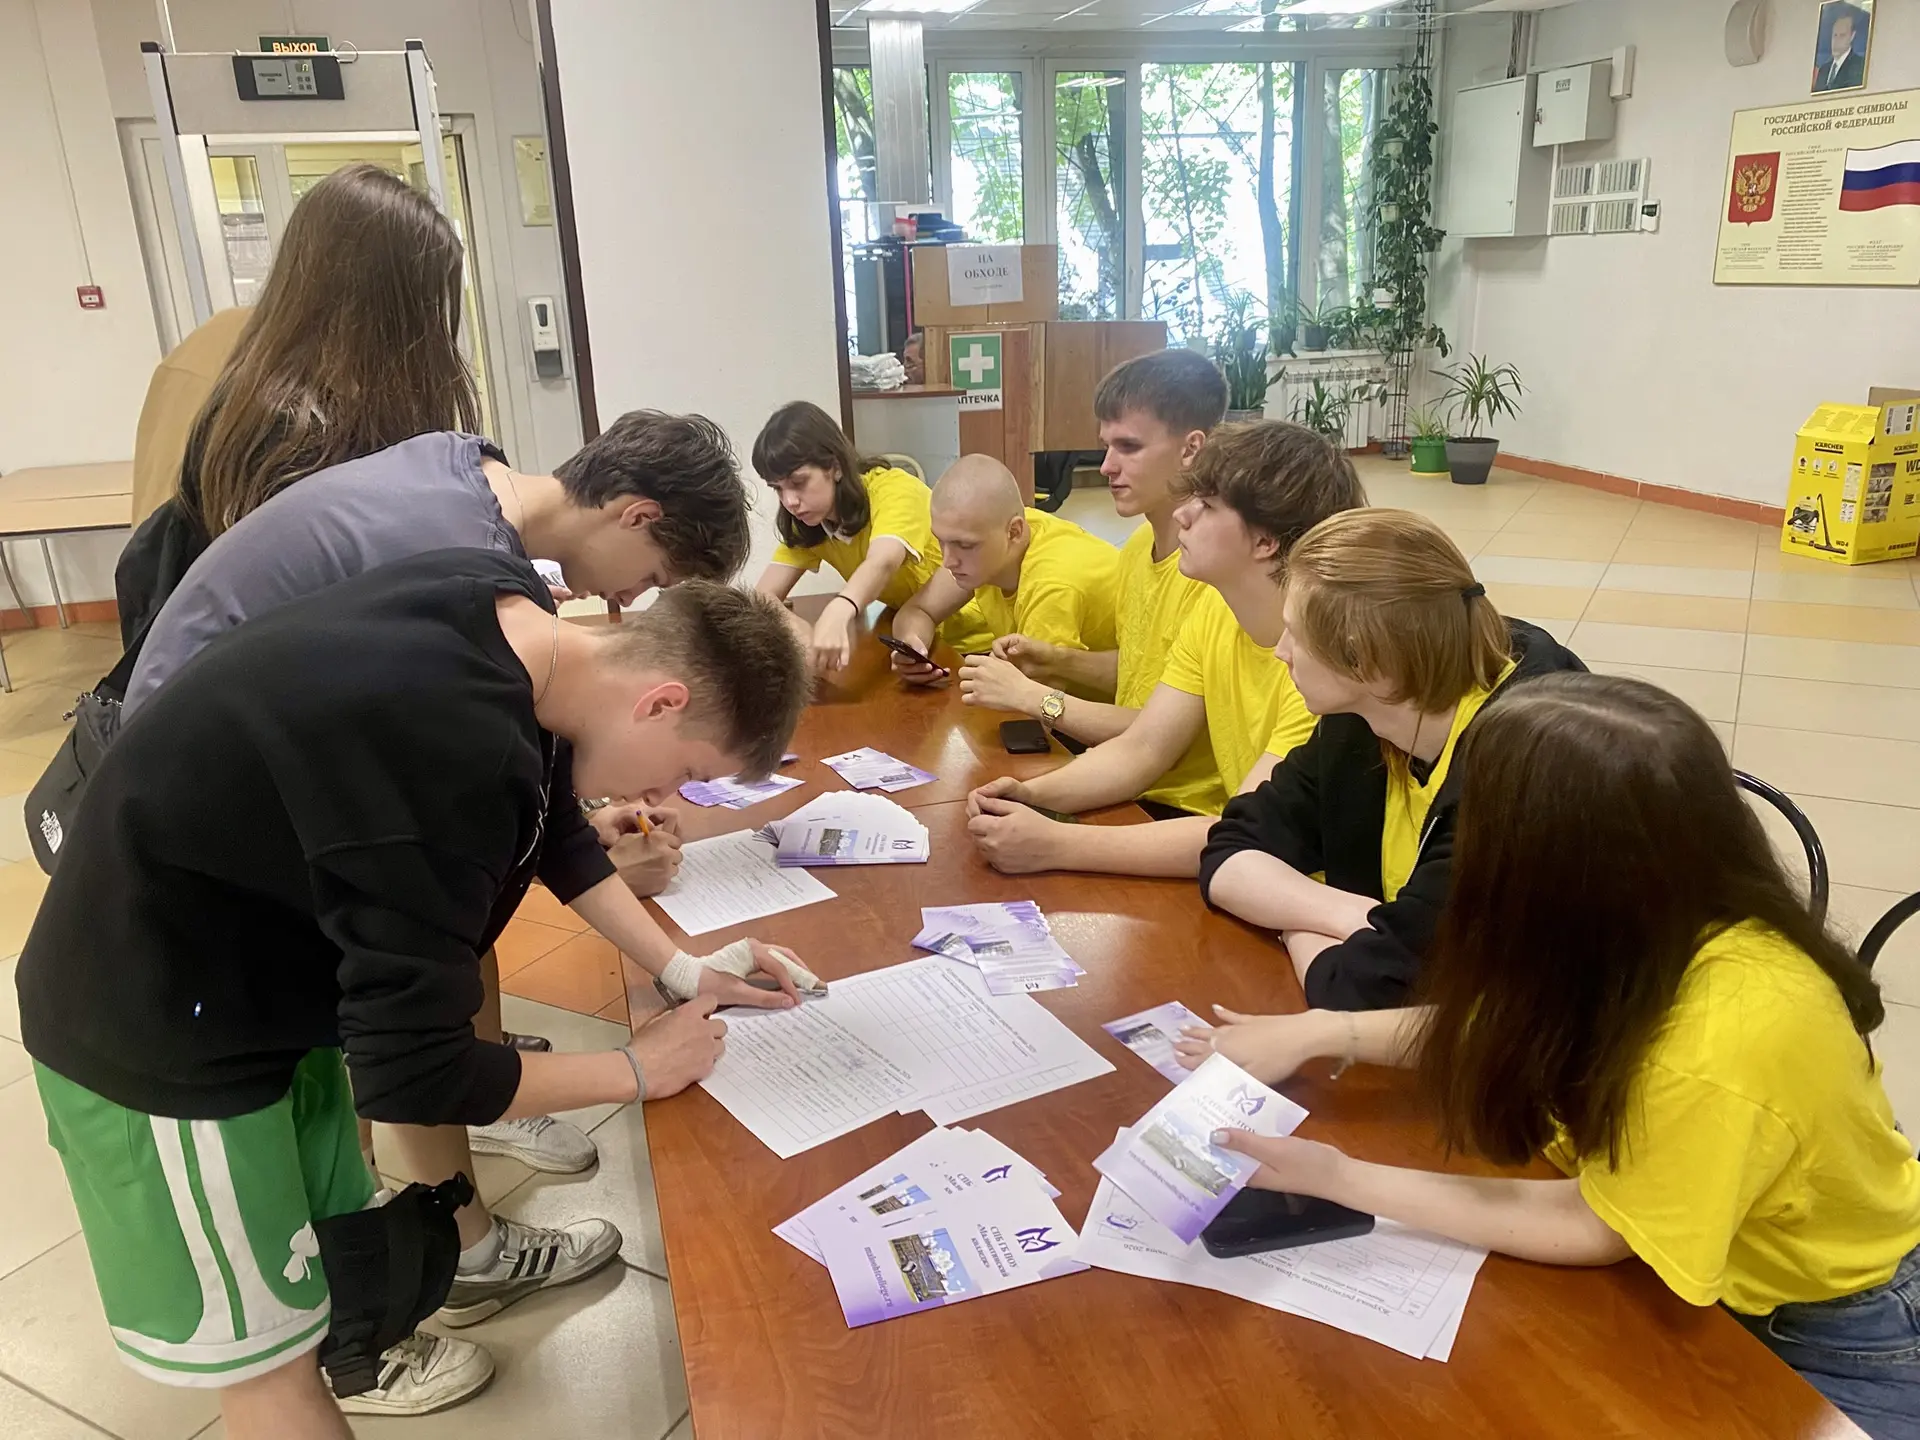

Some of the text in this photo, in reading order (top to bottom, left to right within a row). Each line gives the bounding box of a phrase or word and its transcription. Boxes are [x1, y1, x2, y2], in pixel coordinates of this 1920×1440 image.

[272, 42, 318, 53] ВЫХОД
[1763, 101, 1909, 125] ГОСУДАРСТВЕННЫЕ СИМВОЛЫ
[1771, 115, 1896, 136] РОССИЙСКОЙ ФЕДЕРАЦИИ
[977, 254, 994, 264] НА
[964, 267, 1009, 279] ОБХОДЕ
